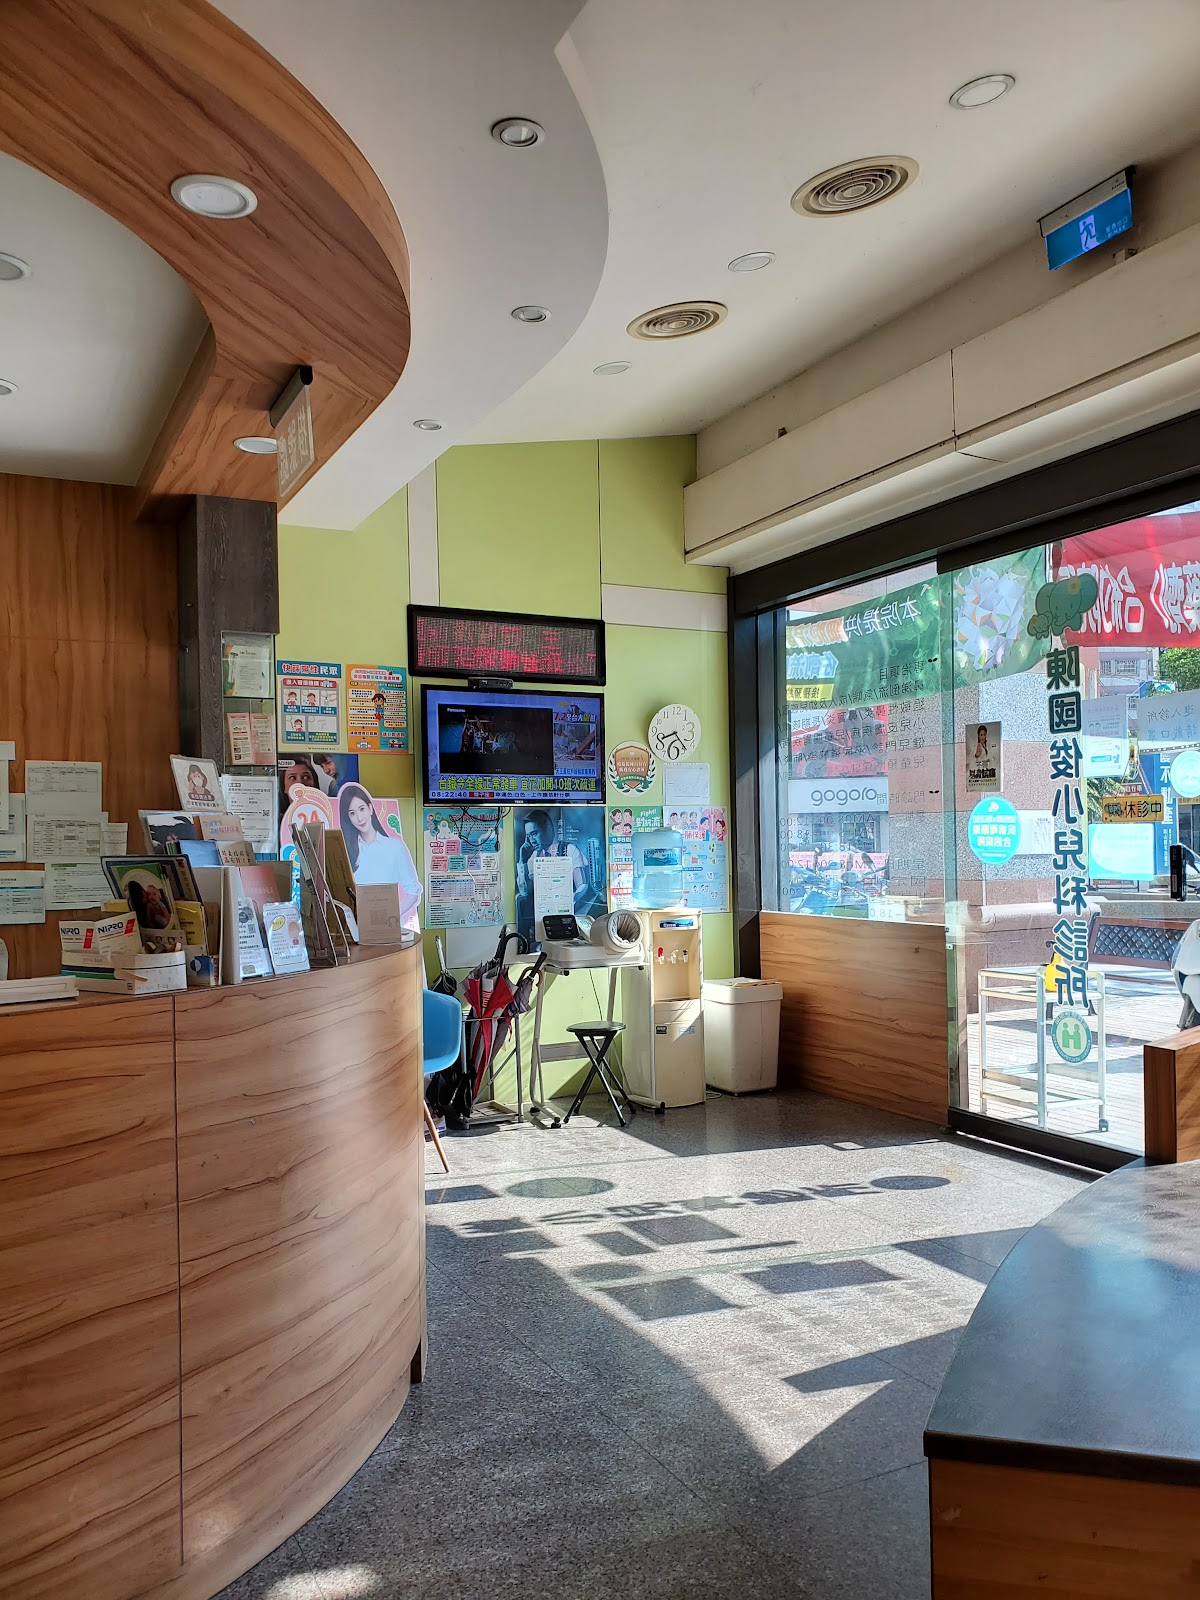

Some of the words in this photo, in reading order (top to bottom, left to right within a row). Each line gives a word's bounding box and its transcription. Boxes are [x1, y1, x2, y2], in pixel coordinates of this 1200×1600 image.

[672, 706, 681, 715] 12
[651, 726, 658, 737] 9
[683, 721, 695, 742] 3
[655, 732, 665, 751] 8
[667, 738, 680, 760] 6
[438, 775, 518, 791] 台鐵今全線正常發車
[811, 786, 877, 807] gogoro
[297, 810, 321, 828] 24
[60, 927, 80, 936] NIPRO
[97, 921, 124, 935] NIPRO
